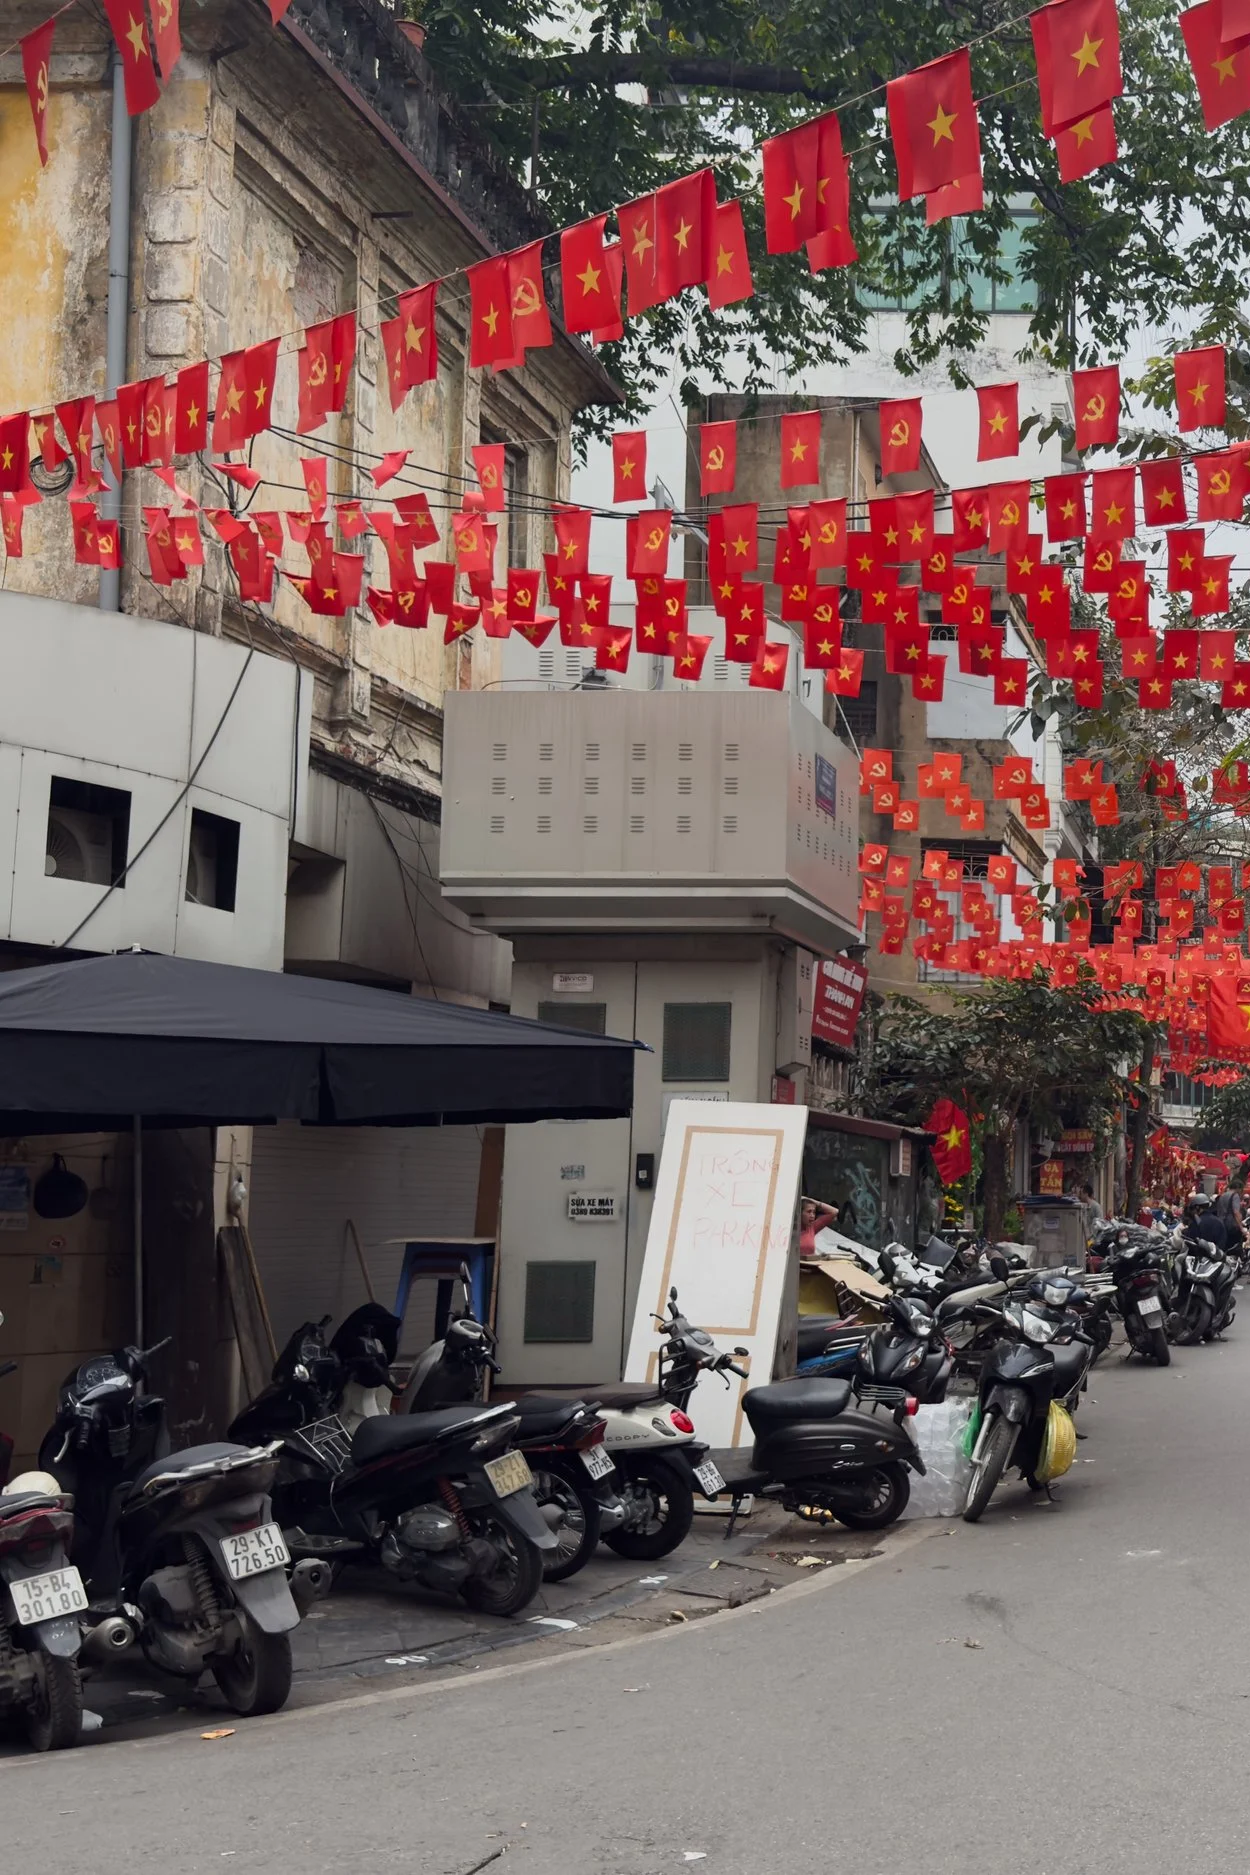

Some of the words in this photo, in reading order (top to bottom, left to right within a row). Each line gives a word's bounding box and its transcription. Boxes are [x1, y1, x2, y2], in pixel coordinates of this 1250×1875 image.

[587, 1198, 596, 1207] XE
[606, 1434, 650, 1443] COOPY
[230, 1528, 273, 1556] 29-K1
[231, 1545, 285, 1576] 726.50
[23, 1572, 71, 1600] 15-B4
[20, 1590, 83, 1622] 301.80
